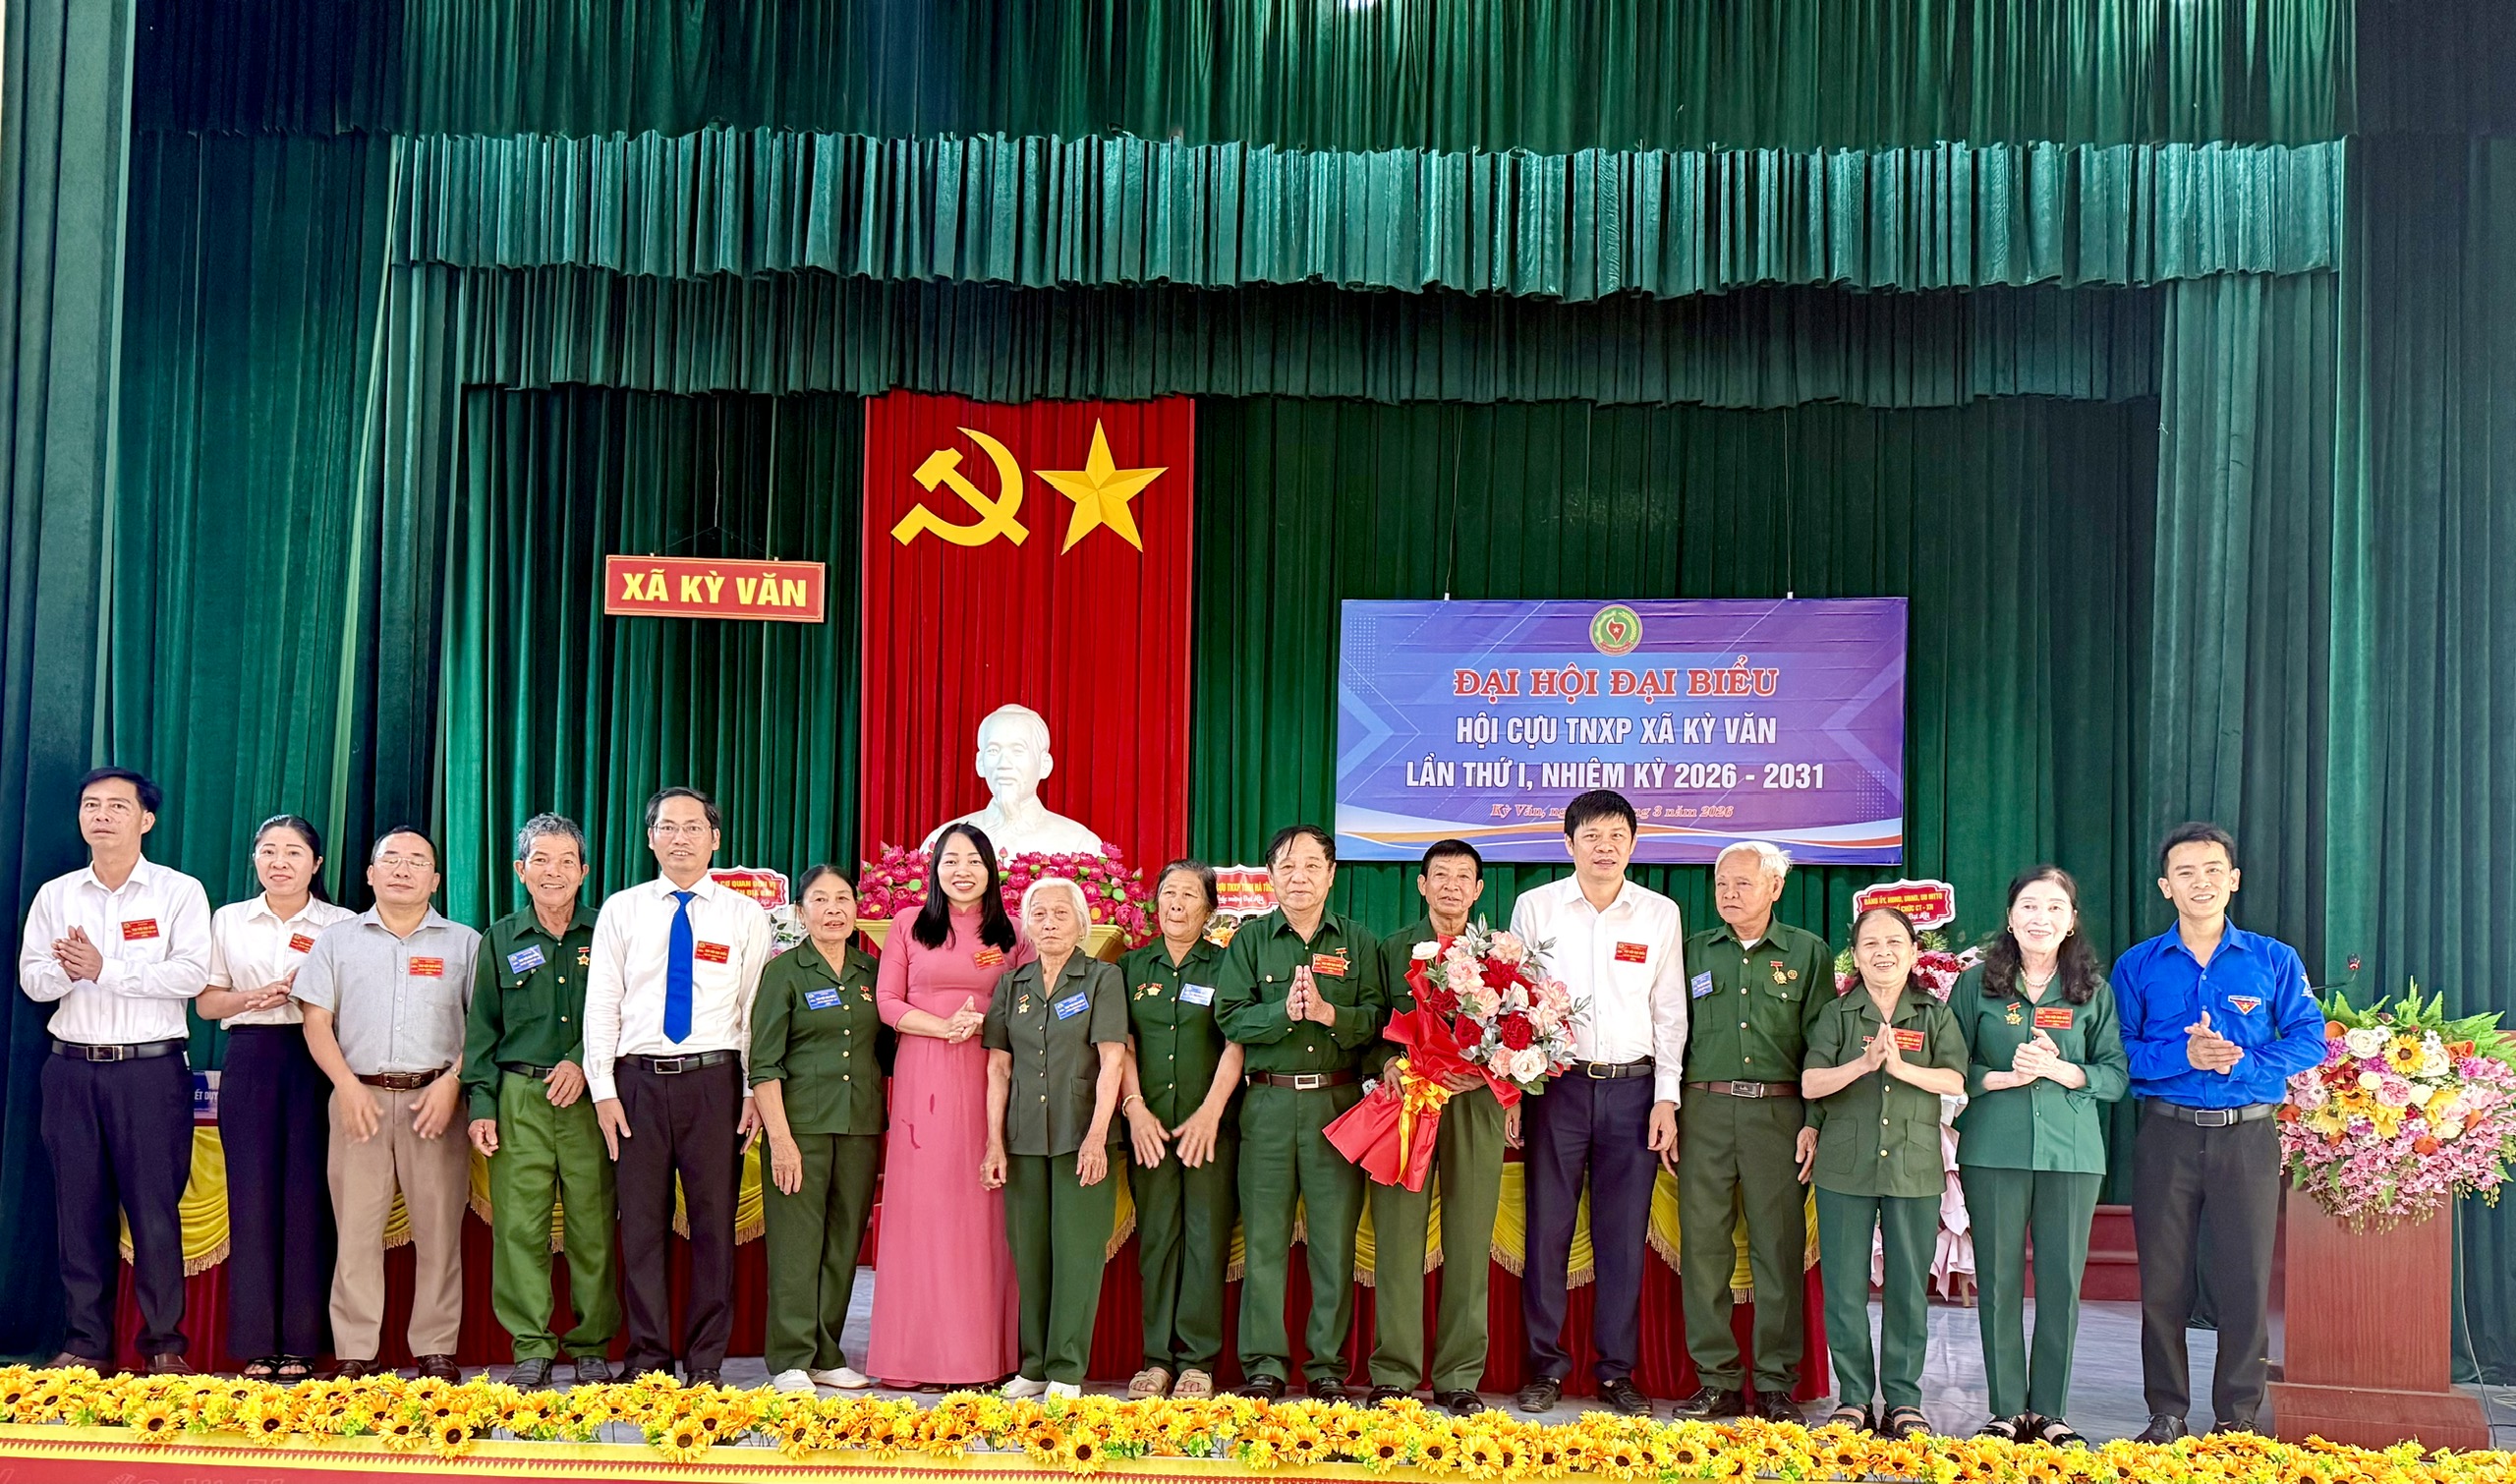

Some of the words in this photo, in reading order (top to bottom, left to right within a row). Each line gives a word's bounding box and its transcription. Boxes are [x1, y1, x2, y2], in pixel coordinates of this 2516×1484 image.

[621, 568, 669, 601] XÃ
[680, 570, 725, 603] KỲ
[736, 572, 807, 607] VĂN
[1454, 668, 1519, 704] ĐẠI
[1529, 661, 1599, 704] HỘI
[1609, 668, 1677, 704] ĐẠI
[1687, 655, 1779, 697] BIỂU
[1457, 712, 1499, 750] HỘI
[1507, 714, 1558, 750] CỰU
[1565, 716, 1632, 744] TNXP
[1640, 712, 1675, 744] XÃ
[1683, 712, 1716, 744] KỲ
[1724, 712, 1777, 744] VĂN
[1406, 752, 1455, 787] LẦN
[1462, 756, 1514, 788] THỨ
[1517, 763, 1533, 791] I,
[1541, 757, 1626, 790] NHIỆM
[1633, 757, 1667, 788] KỲ
[1674, 763, 1737, 788] 2026
[1763, 763, 1825, 788] 2031
[1490, 804, 1512, 819] Kỳ
[1515, 804, 1546, 819] Văn,
[1549, 807, 1567, 819] ng
[1652, 805, 1663, 817] 3
[1664, 805, 1697, 818] năm
[1699, 805, 1734, 818] 2026
